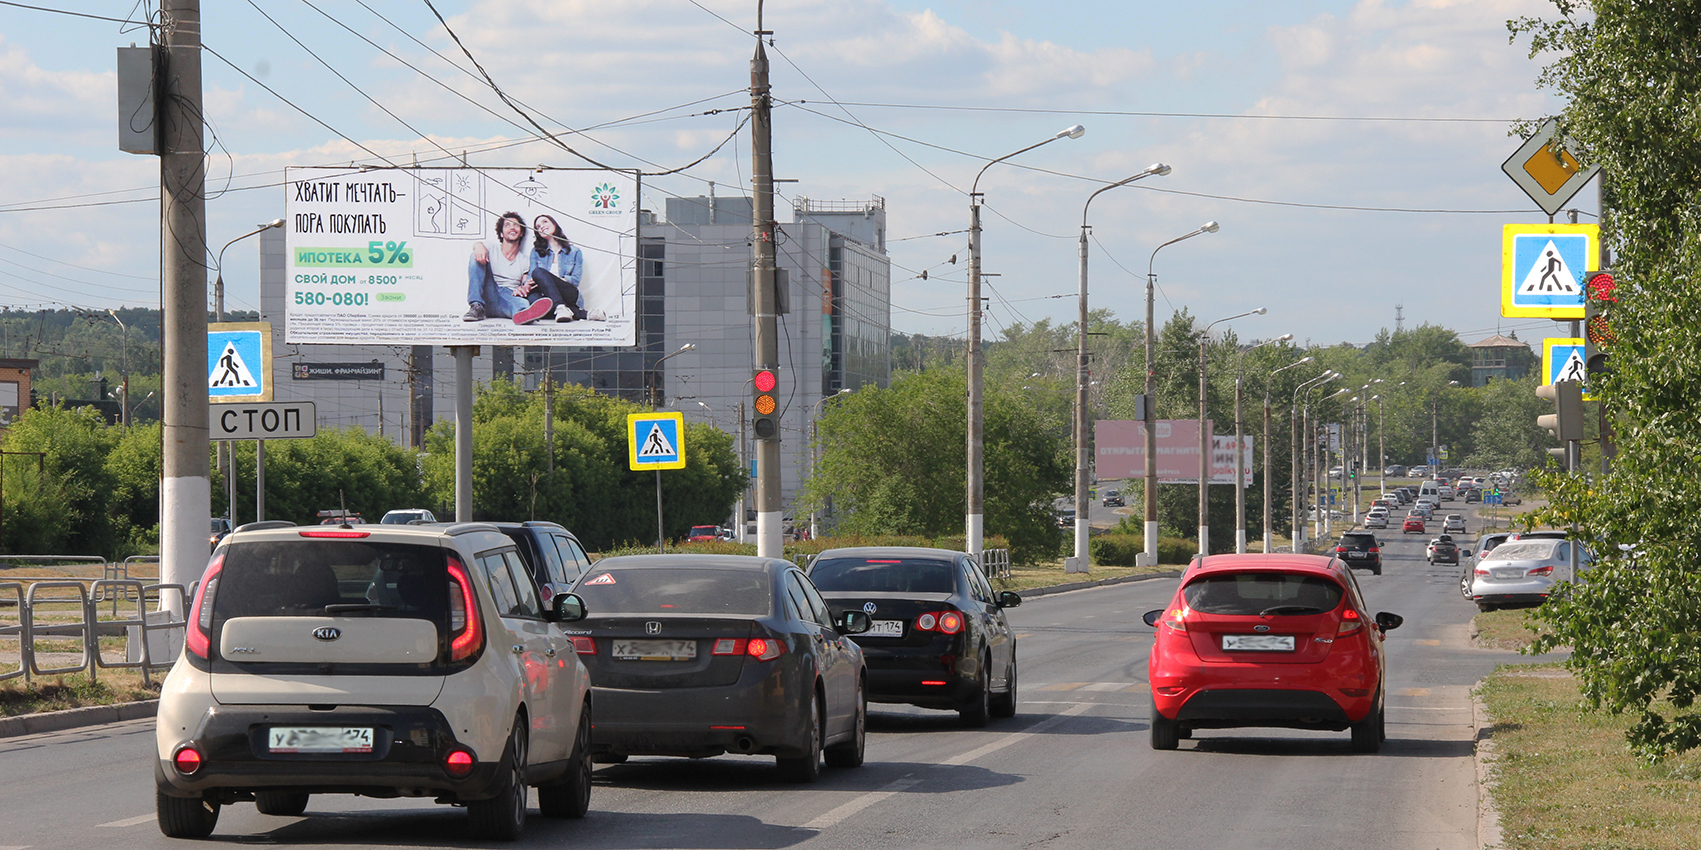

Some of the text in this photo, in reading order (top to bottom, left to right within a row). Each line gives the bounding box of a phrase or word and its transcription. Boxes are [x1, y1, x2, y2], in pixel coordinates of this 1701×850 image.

[295, 182, 340, 203] ХВАТИТ
[295, 213, 387, 234] ПОРА ПОКУПАТЬ
[298, 240, 410, 264] ИПОТЕКА 5%
[294, 273, 328, 285] СВОЙ
[330, 274, 356, 286] ДОМ
[294, 291, 369, 306] 580-080!
[220, 408, 300, 433] СТОП
[317, 629, 337, 638] KIA
[884, 621, 900, 630] 174
